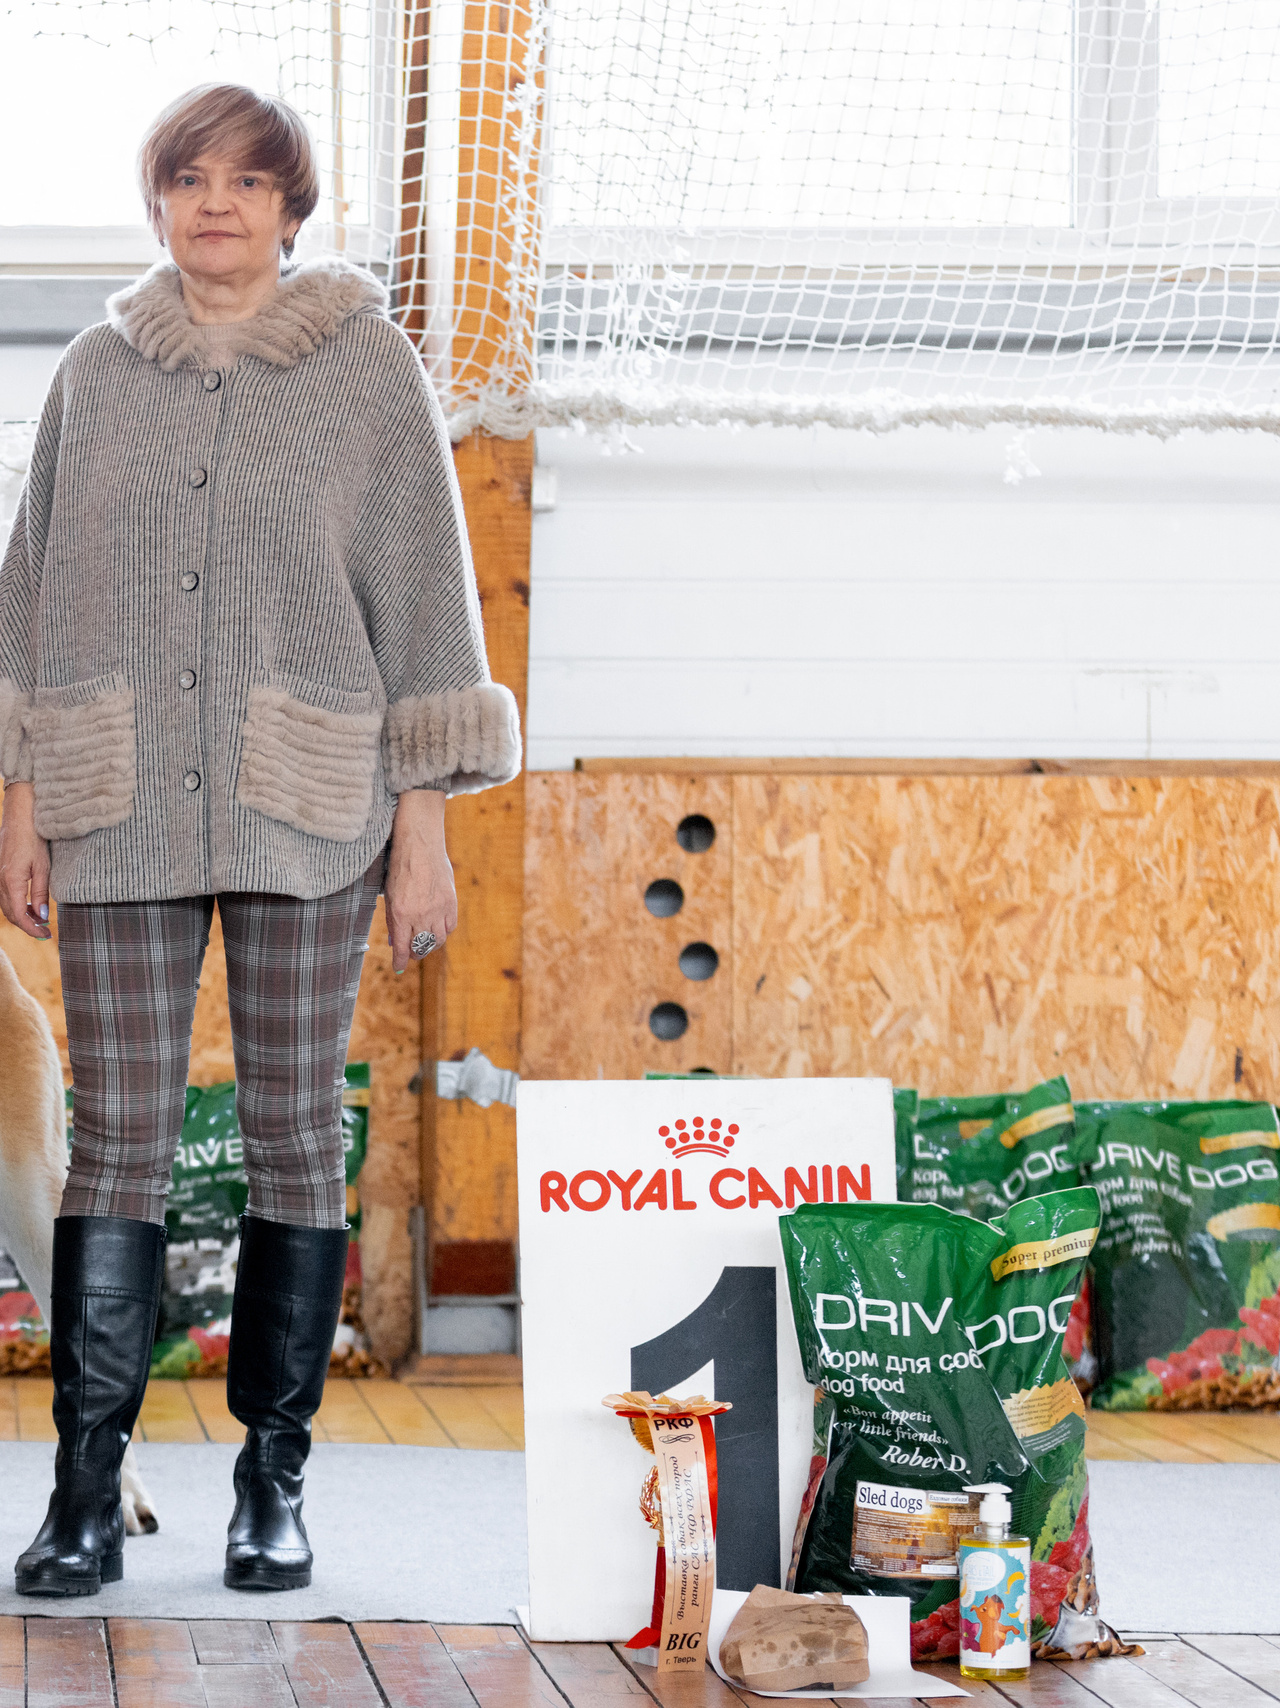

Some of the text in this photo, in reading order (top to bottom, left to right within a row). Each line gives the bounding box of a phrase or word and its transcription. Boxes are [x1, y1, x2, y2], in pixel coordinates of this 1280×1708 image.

[1187, 1159, 1279, 1190] DOG
[540, 1164, 872, 1213] ROYAL CANIN
[1001, 1250, 1038, 1269] Super
[886, 1355, 931, 1375] для
[820, 1373, 905, 1397] dog food
[630, 1266, 780, 1590] 1
[653, 1417, 694, 1431] РКФ
[860, 1419, 892, 1437] little
[881, 1409, 932, 1426] appetit
[879, 1444, 971, 1475] Rober D.
[858, 1486, 923, 1514] Sled dogs
[669, 1456, 690, 1621] Выставка собак всех пород
[691, 1574, 699, 1607] ранга
[666, 1632, 702, 1651] BIG
[673, 1656, 697, 1665] Тверь
